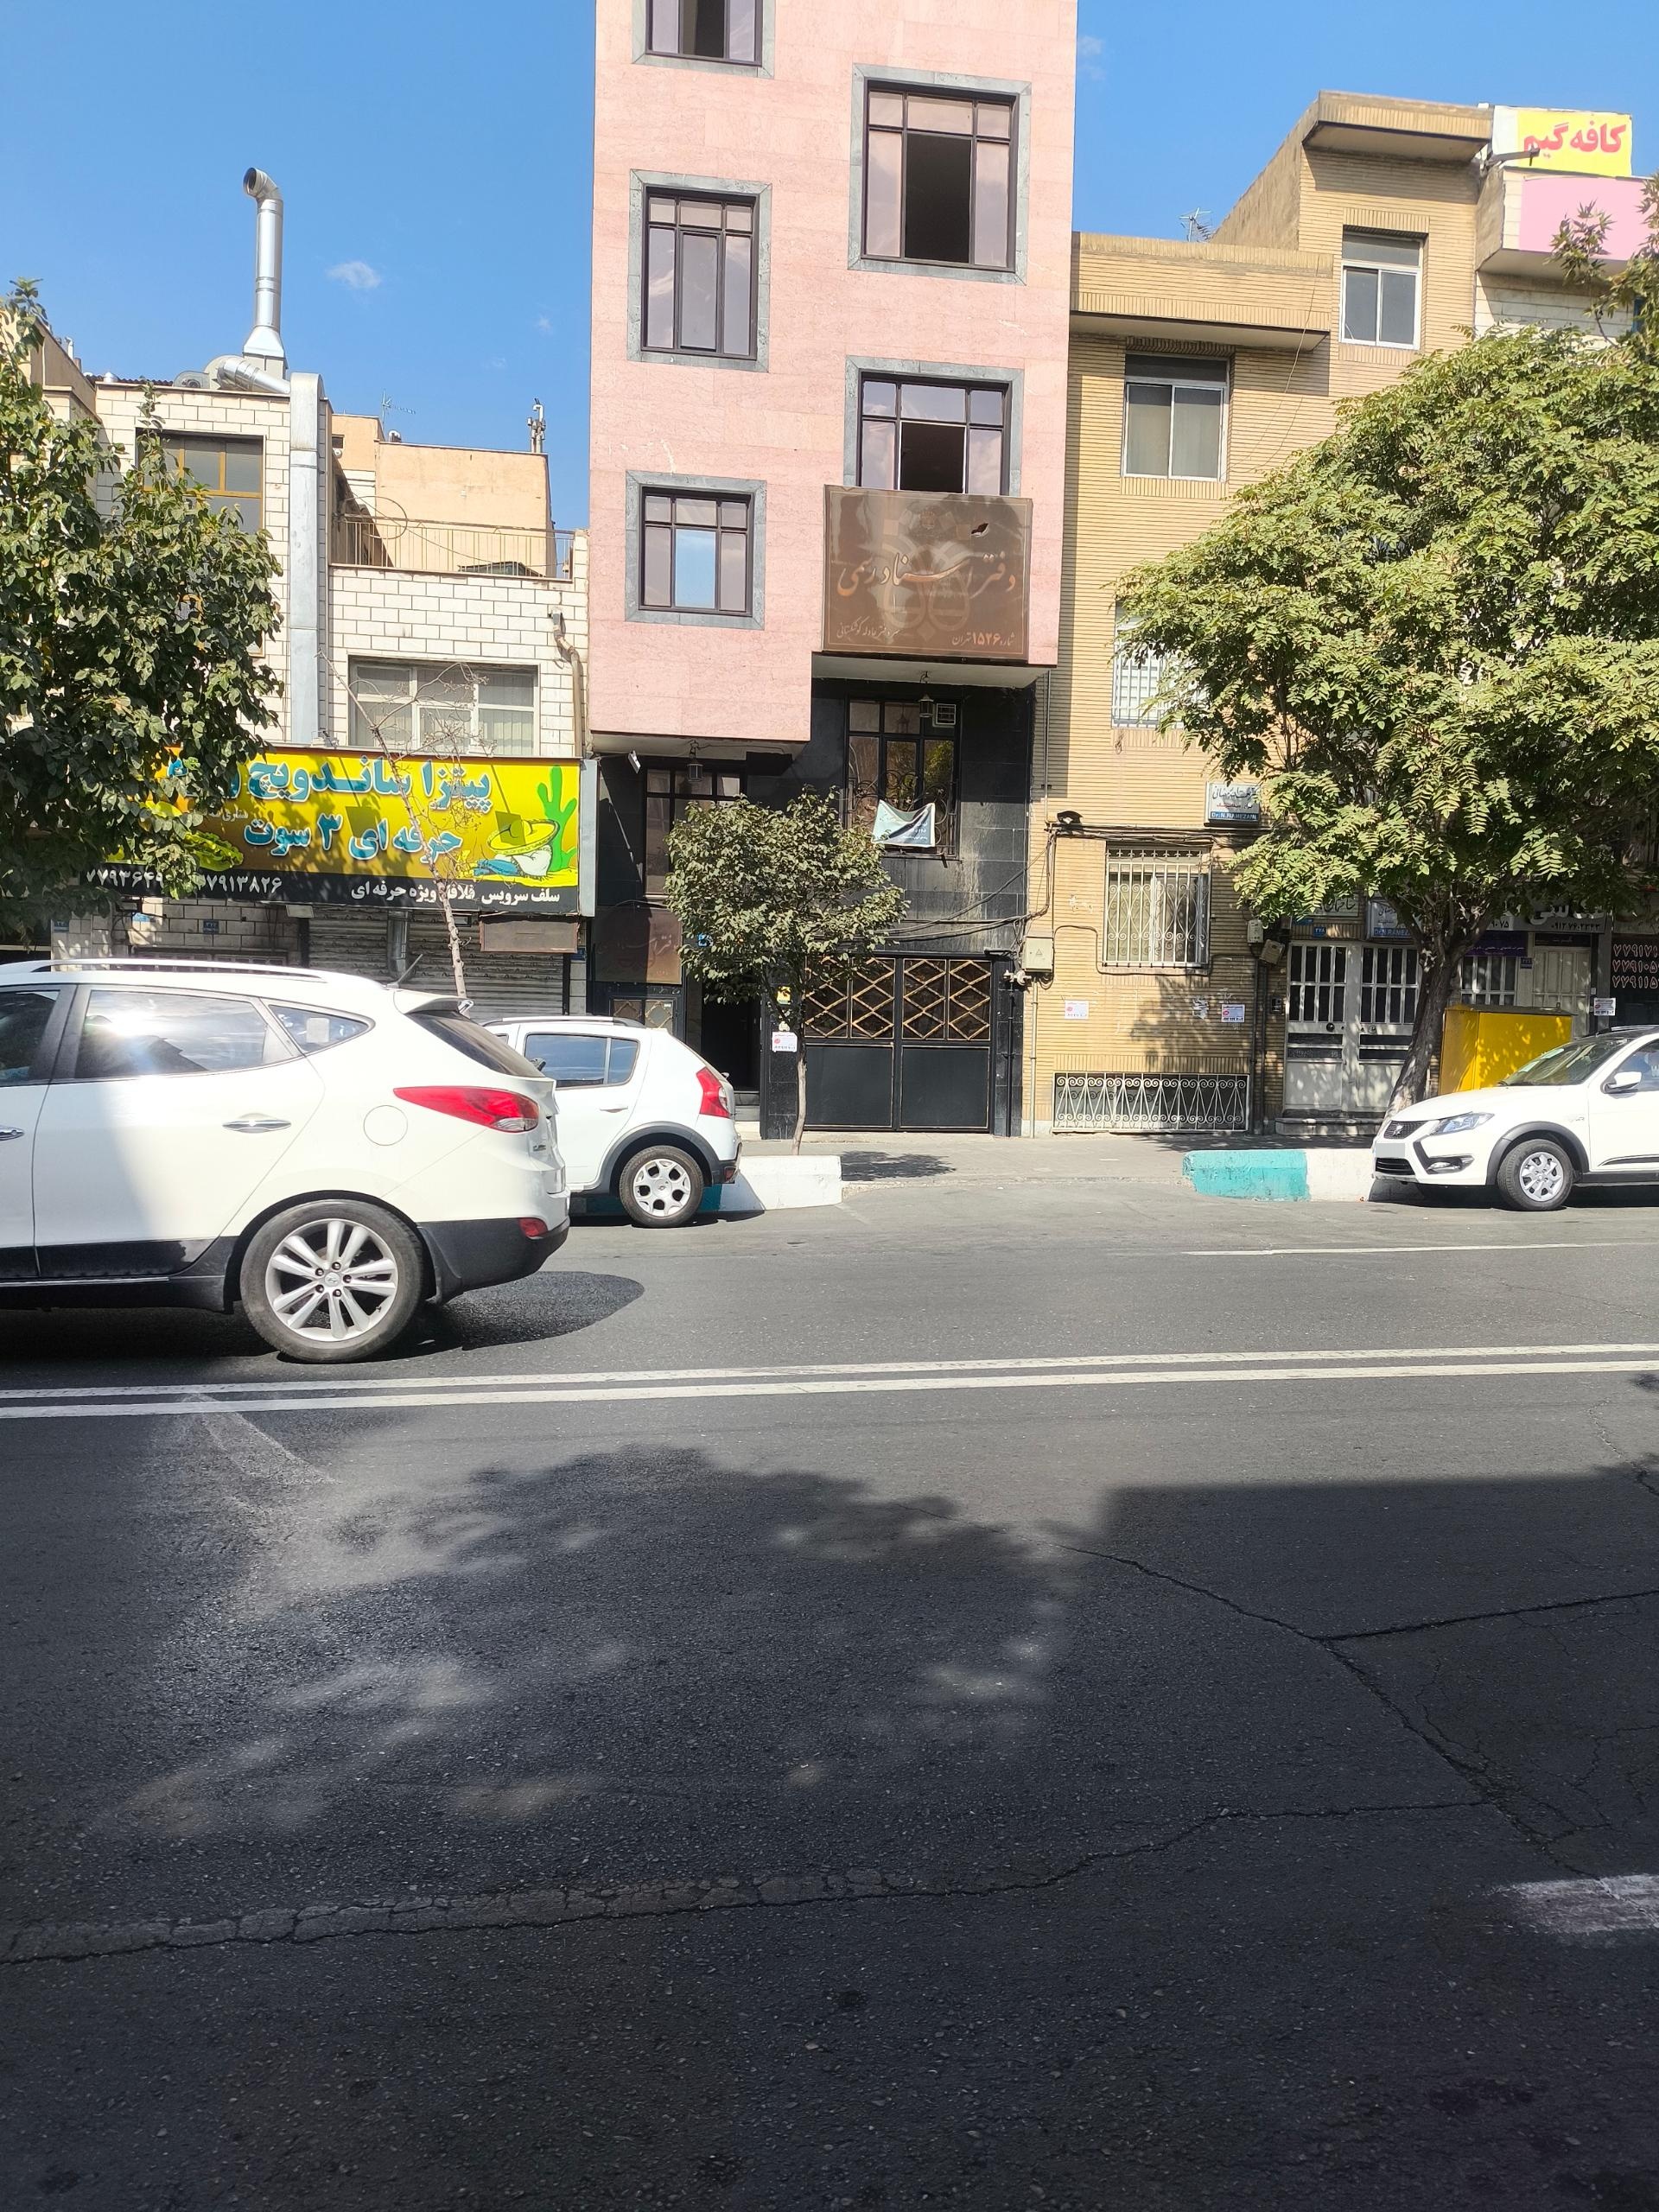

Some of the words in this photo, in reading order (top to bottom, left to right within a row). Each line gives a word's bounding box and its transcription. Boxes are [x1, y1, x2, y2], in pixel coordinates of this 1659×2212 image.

[1523, 122, 1569, 159] گیم
[1569, 120, 1626, 153] کافه
[837, 557, 876, 597] رسمی
[880, 552, 973, 589] اسناد
[969, 550, 1017, 599] دفتر
[951, 632, 972, 645] تهران
[247, 755, 412, 803] ساندویچ
[421, 759, 493, 813] پیتزا
[244, 818, 311, 857] سوت
[316, 812, 343, 851] ۳
[349, 817, 388, 860] ای
[392, 820, 463, 864] حرفه
[86, 868, 166, 887] ۷۷۹۳۶۴۹
[200, 874, 283, 893] ۷۹۱۳۸۲۶
[351, 881, 369, 899] ای
[372, 880, 406, 900] حرفه
[410, 883, 436, 903] ویژه
[481, 888, 529, 906] سرویس
[531, 887, 560, 903] سلف
[1612, 960, 1659, 973] ۷۷۹۱۰۵
[1612, 976, 1659, 989] ۷۷۹۱۱۵
